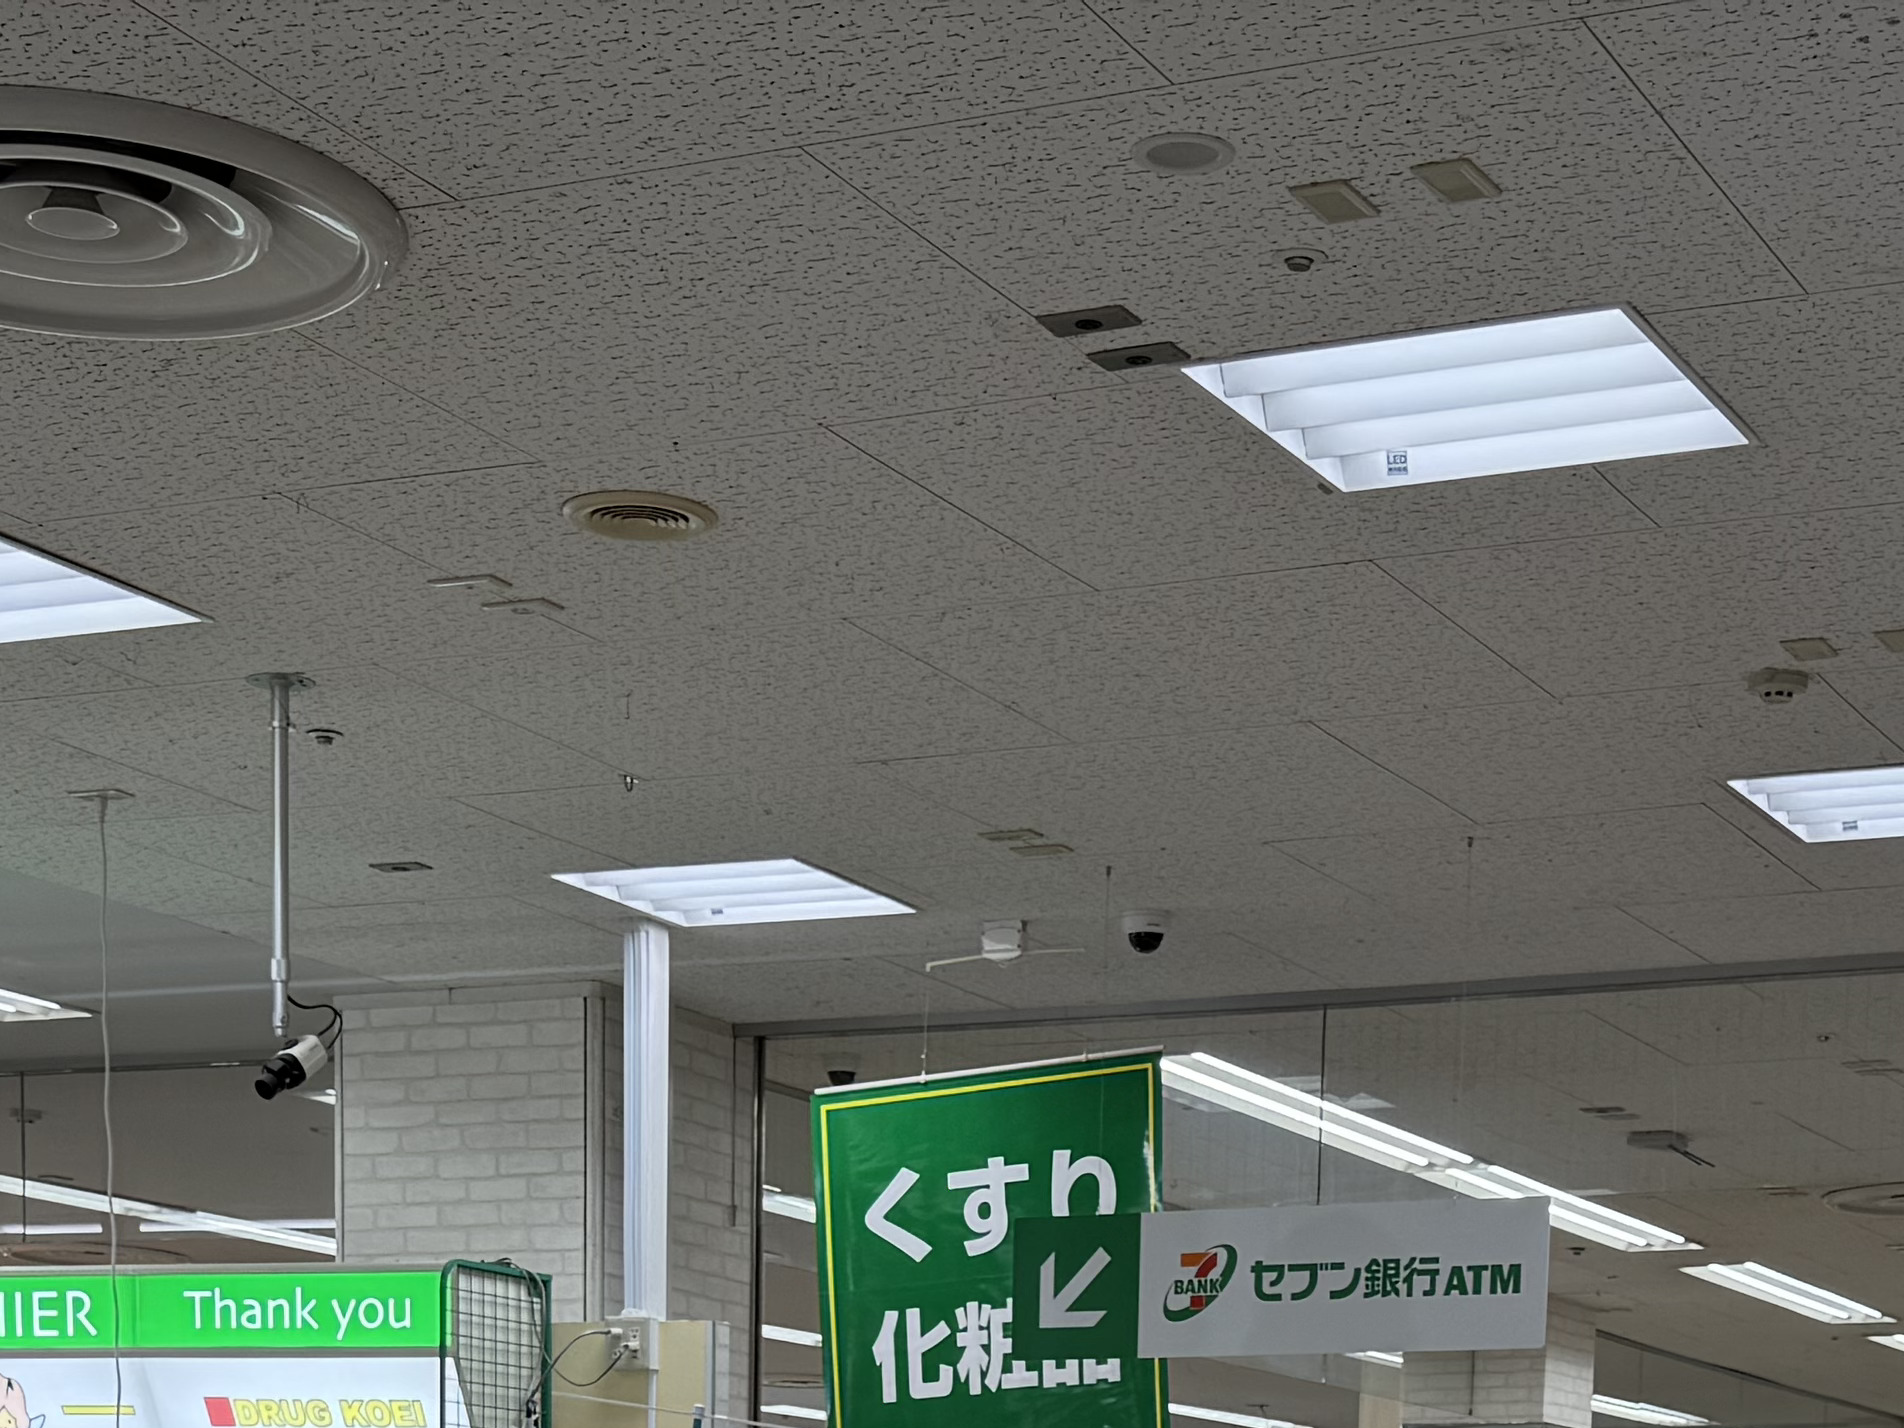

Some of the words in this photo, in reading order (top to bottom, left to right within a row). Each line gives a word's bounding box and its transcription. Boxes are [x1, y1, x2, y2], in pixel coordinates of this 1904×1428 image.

[864, 1148, 1118, 1264] くすり
[1173, 1278, 1223, 1296] BANK
[1249, 1256, 1522, 1303] セブン銀行ATM
[183, 1287, 320, 1333] Thank
[332, 1295, 413, 1341] you
